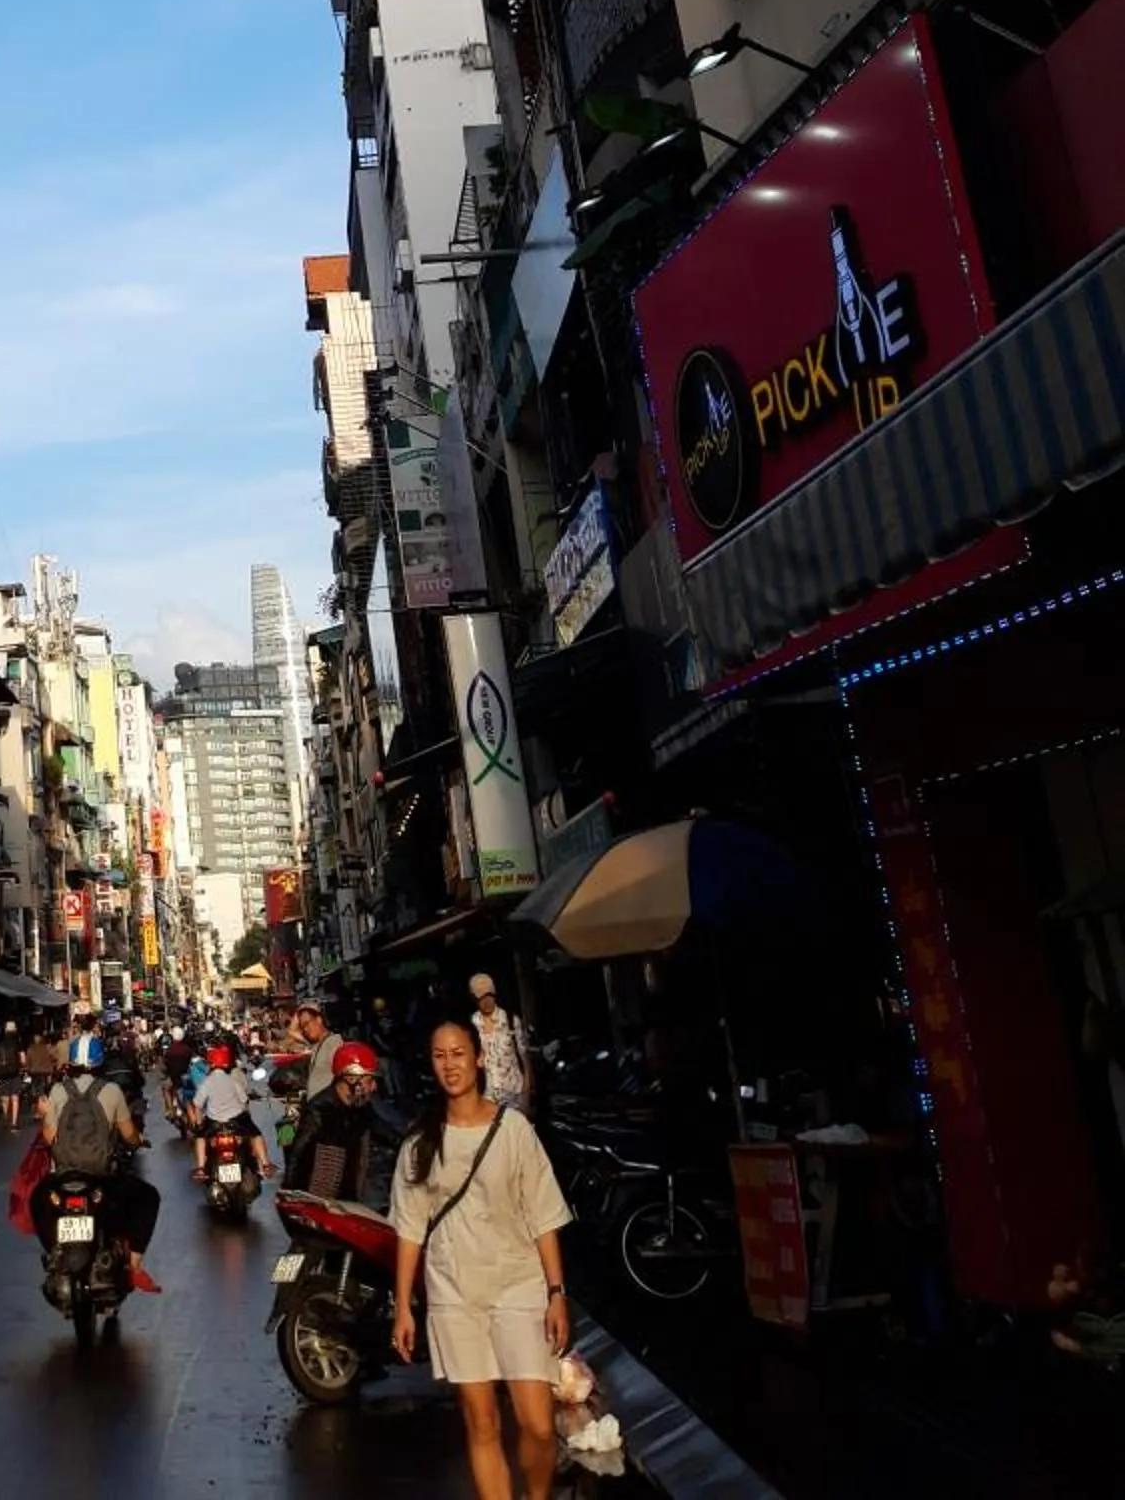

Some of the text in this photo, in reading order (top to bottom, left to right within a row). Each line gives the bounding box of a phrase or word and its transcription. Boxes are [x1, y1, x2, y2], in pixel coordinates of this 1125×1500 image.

[751, 333, 838, 446] PICK
[851, 375, 900, 435] UP
[121, 688, 134, 761] HOTEL
